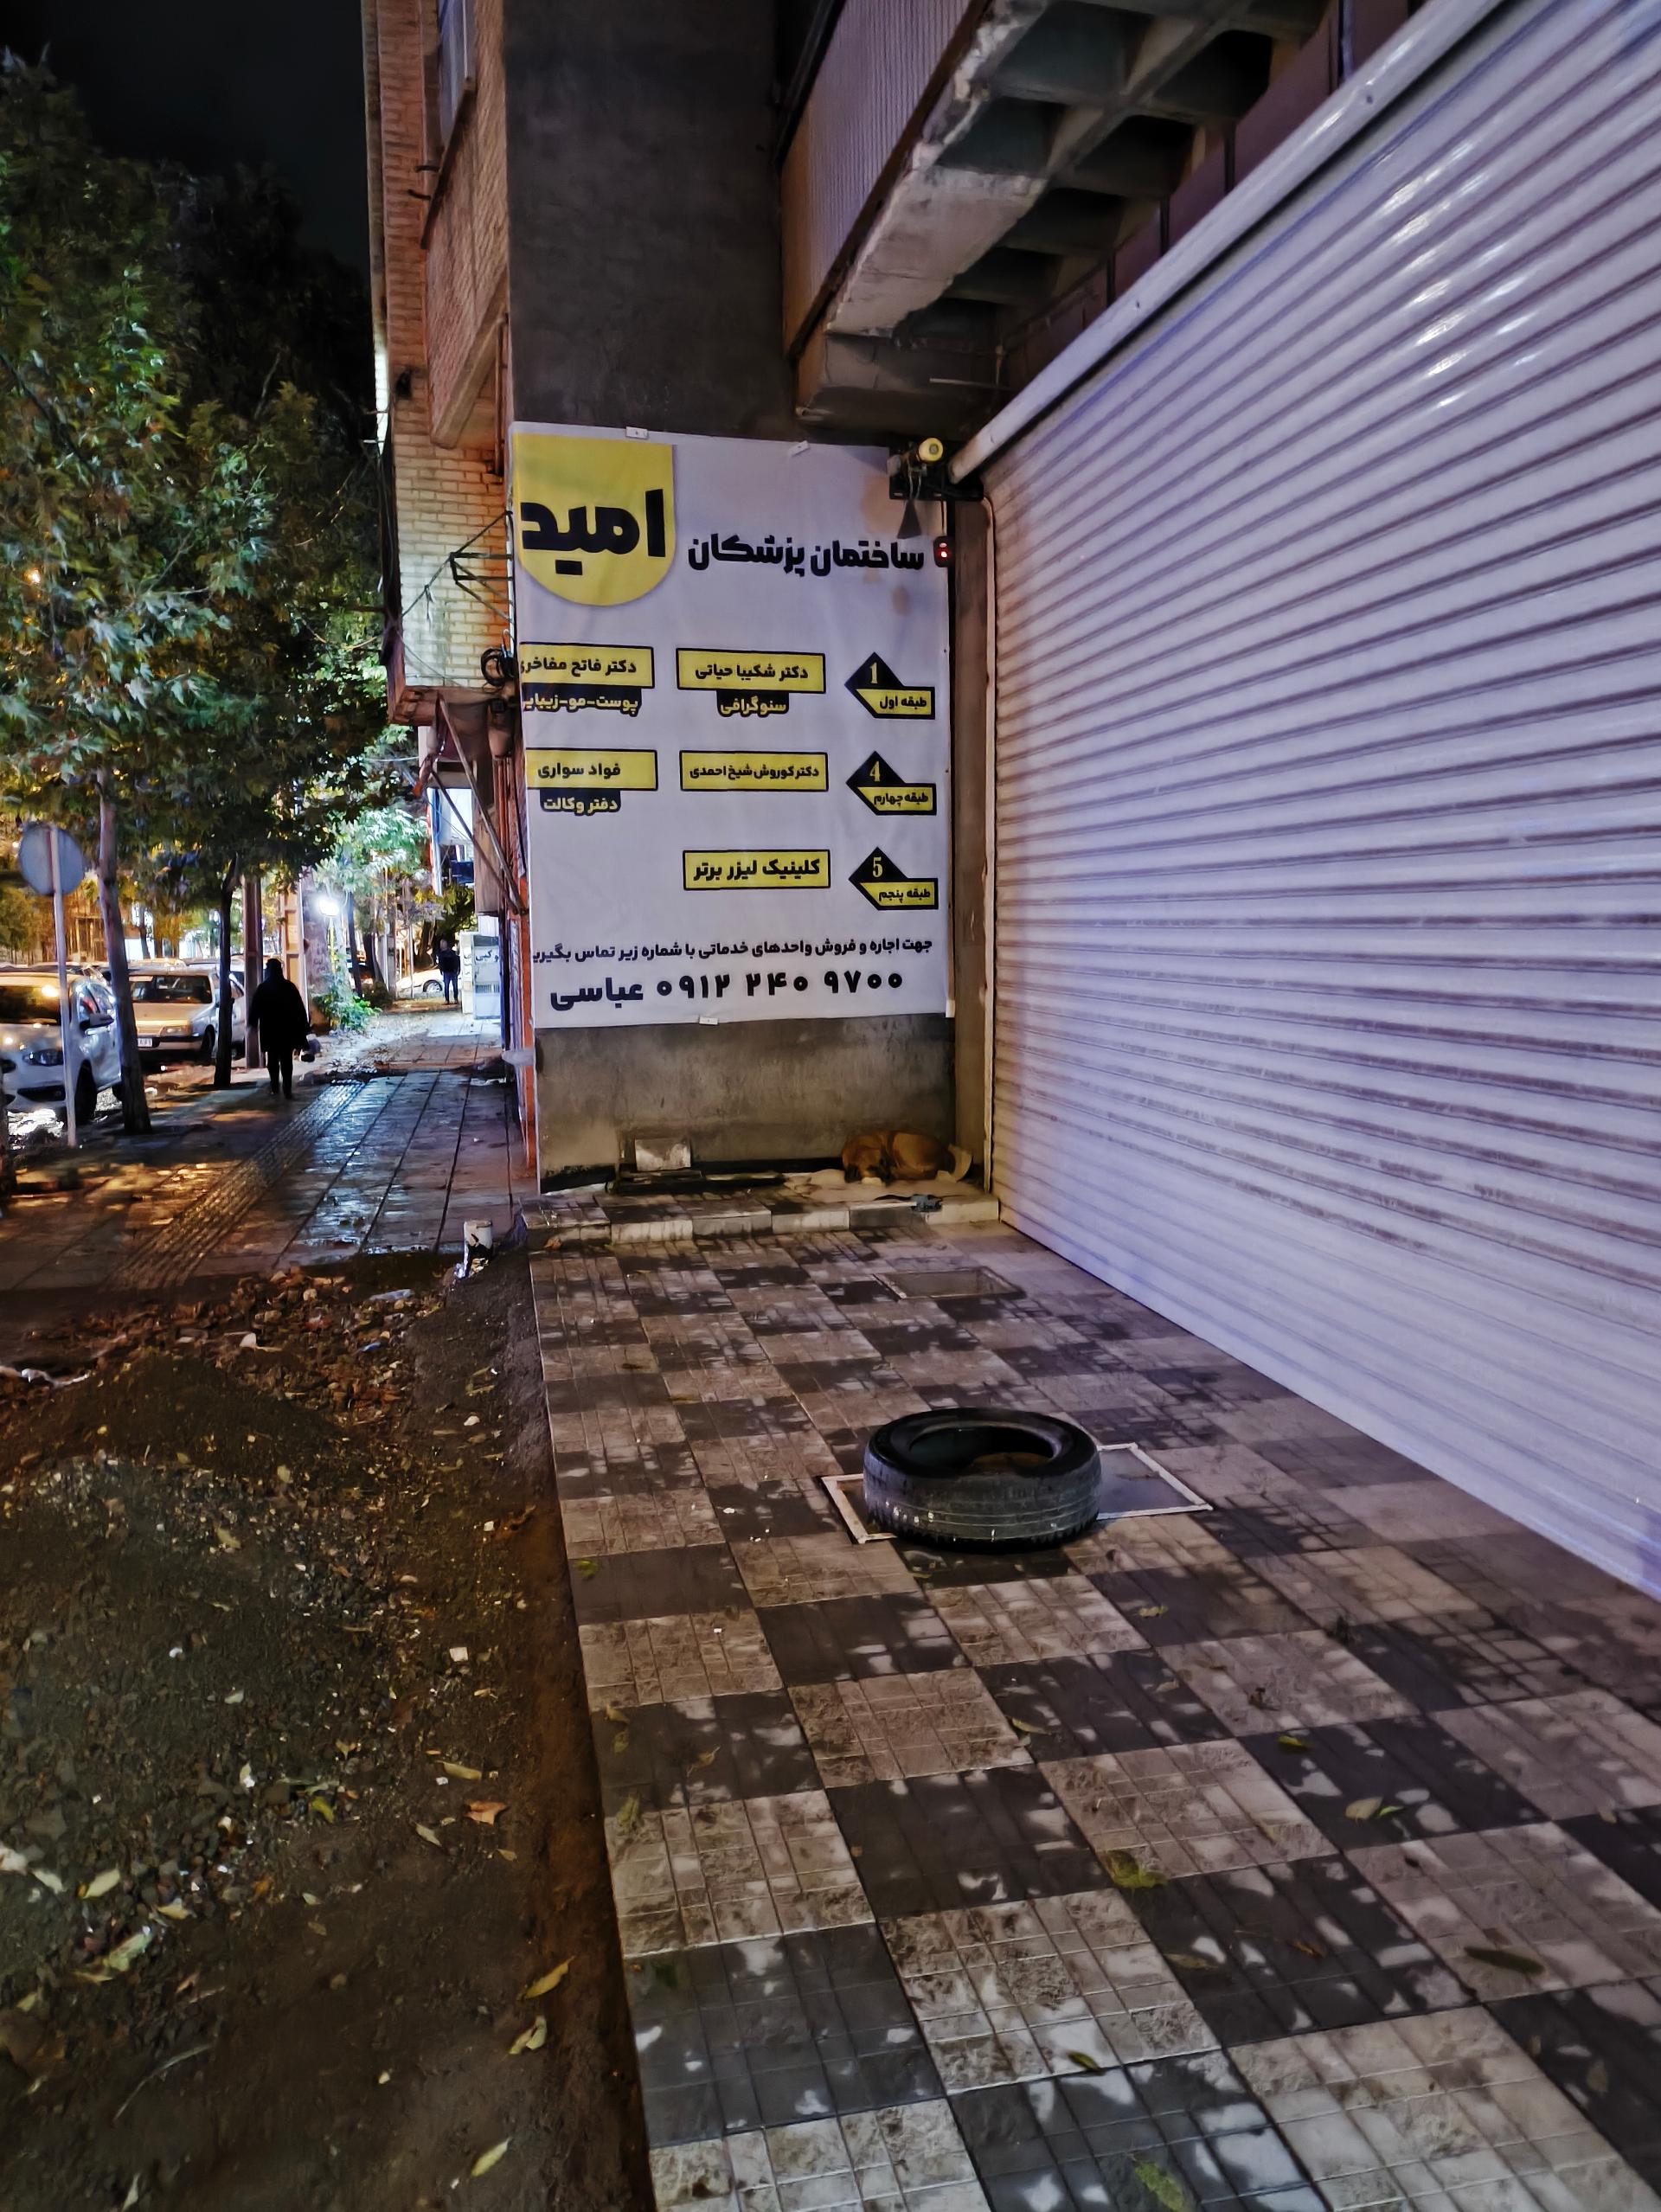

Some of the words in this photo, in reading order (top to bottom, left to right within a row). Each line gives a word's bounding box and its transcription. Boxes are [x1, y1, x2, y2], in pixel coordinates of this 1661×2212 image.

[521, 489, 665, 576] امید
[688, 533, 805, 578] پزشکان
[811, 539, 924, 577] ساختمان
[571, 658, 602, 677] فاتح
[606, 659, 637, 676] دکتر
[696, 664, 733, 680] حیاتی
[737, 664, 776, 681] شکیبا
[779, 665, 808, 682] دکتر
[869, 662, 878, 684] 1
[880, 696, 898, 709] اول
[901, 696, 927, 710] طبقه
[537, 762, 584, 779] سواری
[588, 762, 621, 779] فواد
[689, 766, 727, 779] احمدی
[728, 763, 753, 780] شیخ
[754, 764, 794, 779] کوروش
[794, 766, 819, 779] دکتر
[869, 760, 881, 782] 4
[543, 797, 585, 814] وکالت
[587, 797, 619, 814] دفتر
[874, 792, 903, 807] چهارم
[904, 792, 928, 805] طبقه
[694, 862, 722, 882] برتر
[727, 859, 757, 881] لیزر
[762, 858, 820, 880] کلینیک
[872, 856, 882, 878] 5
[878, 889, 904, 903] پنجم
[906, 888, 931, 901] طبقه
[533, 942, 571, 964] بگیری
[574, 946, 615, 963] تماس
[618, 946, 638, 962] زیر
[641, 942, 683, 961] شماره
[685, 944, 695, 959] با
[698, 941, 749, 959] خدماتی
[752, 940, 812, 958] واحدهای
[815, 938, 856, 957] فروش
[859, 943, 867, 955] و
[869, 938, 900, 955] اجاره
[902, 939, 933, 953] جهت
[657, 974, 730, 999] ۰۹۱۲
[745, 971, 809, 997] ۲۴۰
[824, 970, 902, 994] ۹۷۰۰
[550, 977, 644, 1011] عباسی
